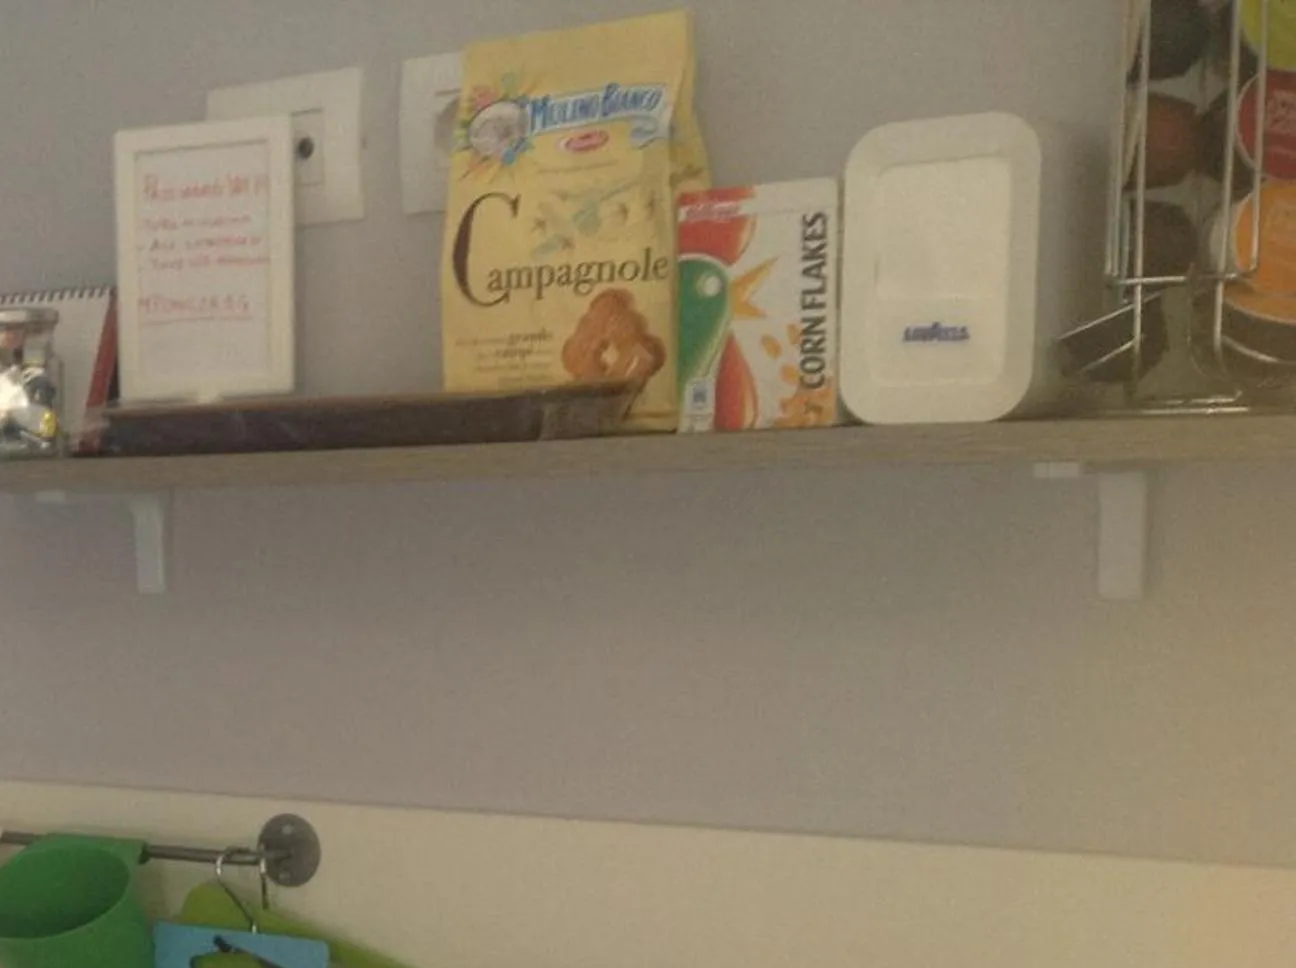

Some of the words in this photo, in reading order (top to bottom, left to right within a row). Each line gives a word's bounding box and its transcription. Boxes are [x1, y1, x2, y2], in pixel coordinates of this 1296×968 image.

[453, 191, 668, 308] Campagnole
[801, 211, 828, 311] FLAKES
[799, 315, 827, 390] CORN
